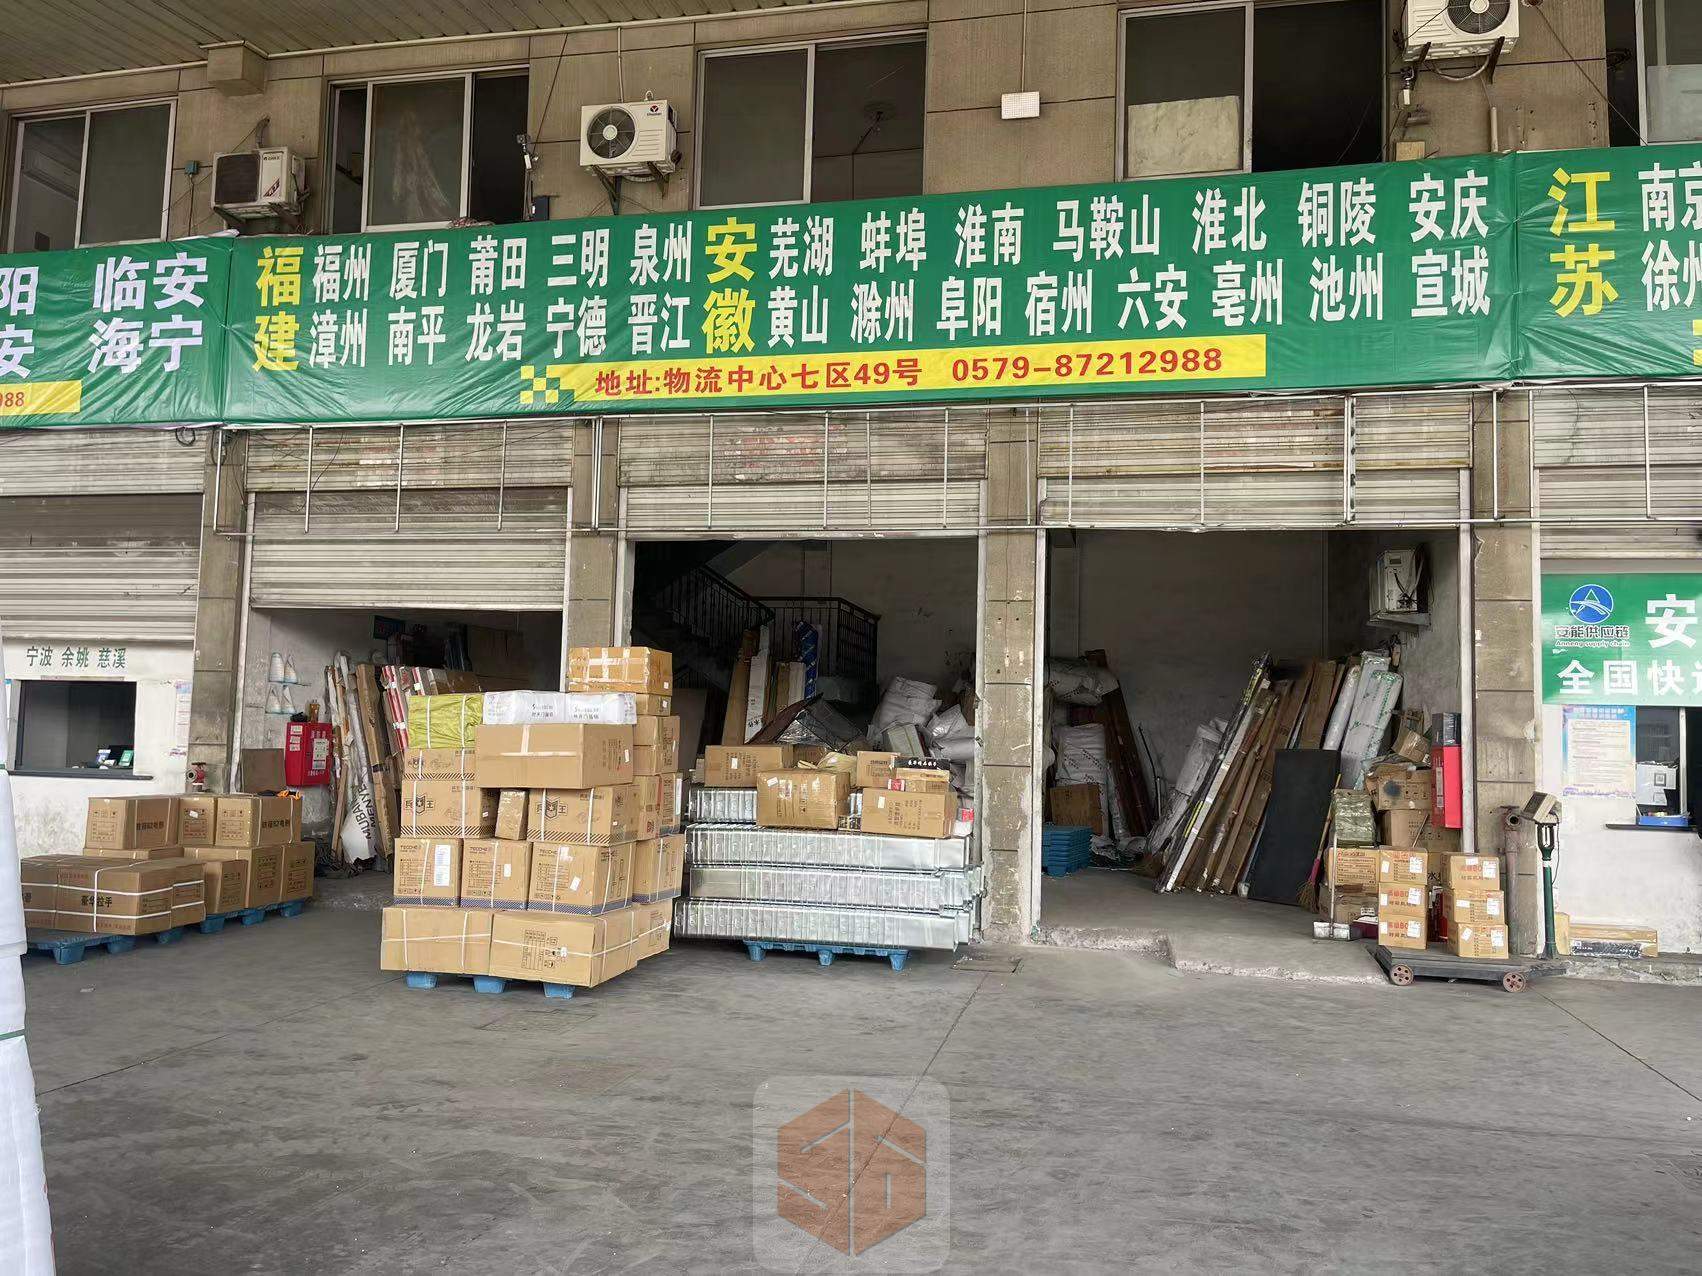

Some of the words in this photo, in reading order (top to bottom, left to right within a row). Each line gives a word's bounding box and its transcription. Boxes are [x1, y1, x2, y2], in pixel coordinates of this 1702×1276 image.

[768, 215, 834, 279] 芜湖
[860, 207, 927, 273] 蚌埠
[954, 202, 1024, 269] 淮南
[1053, 194, 1159, 262] 马鞍山
[1191, 186, 1267, 255] 淮北
[1297, 177, 1377, 248] 铜陵
[1409, 169, 1490, 243] 安庆
[1638, 161, 1702, 231] 南京
[312, 243, 372, 303] 福州
[390, 239, 449, 299] 厦门
[469, 235, 528, 296] 莆田
[547, 229, 610, 288] 三明
[629, 221, 693, 286] 泉州
[1547, 168, 1619, 317] 江苏
[93, 252, 208, 312] 临安
[252, 246, 304, 372] 福建
[701, 216, 757, 355] 安徽
[767, 285, 828, 349] 黄山
[850, 279, 915, 344] 滁州
[937, 275, 1002, 340] 阜阳
[1025, 269, 1092, 337] 宿州
[1117, 263, 1188, 331] 六安
[1309, 252, 1383, 322] 池州
[1411, 245, 1490, 318] 宣城
[88, 314, 204, 374] 海宁
[309, 308, 368, 369] 漳州
[388, 305, 446, 366] 南平
[465, 299, 526, 361] 龙岩
[546, 295, 607, 359] 宁德
[628, 291, 691, 355] 晋江
[595, 357, 922, 395] 地址:物流中心七区49号
[27, 646, 53, 666] 宁波
[61, 646, 89, 667] 余姚
[97, 647, 126, 668] 慈溪
[1645, 594, 1698, 648] 安
